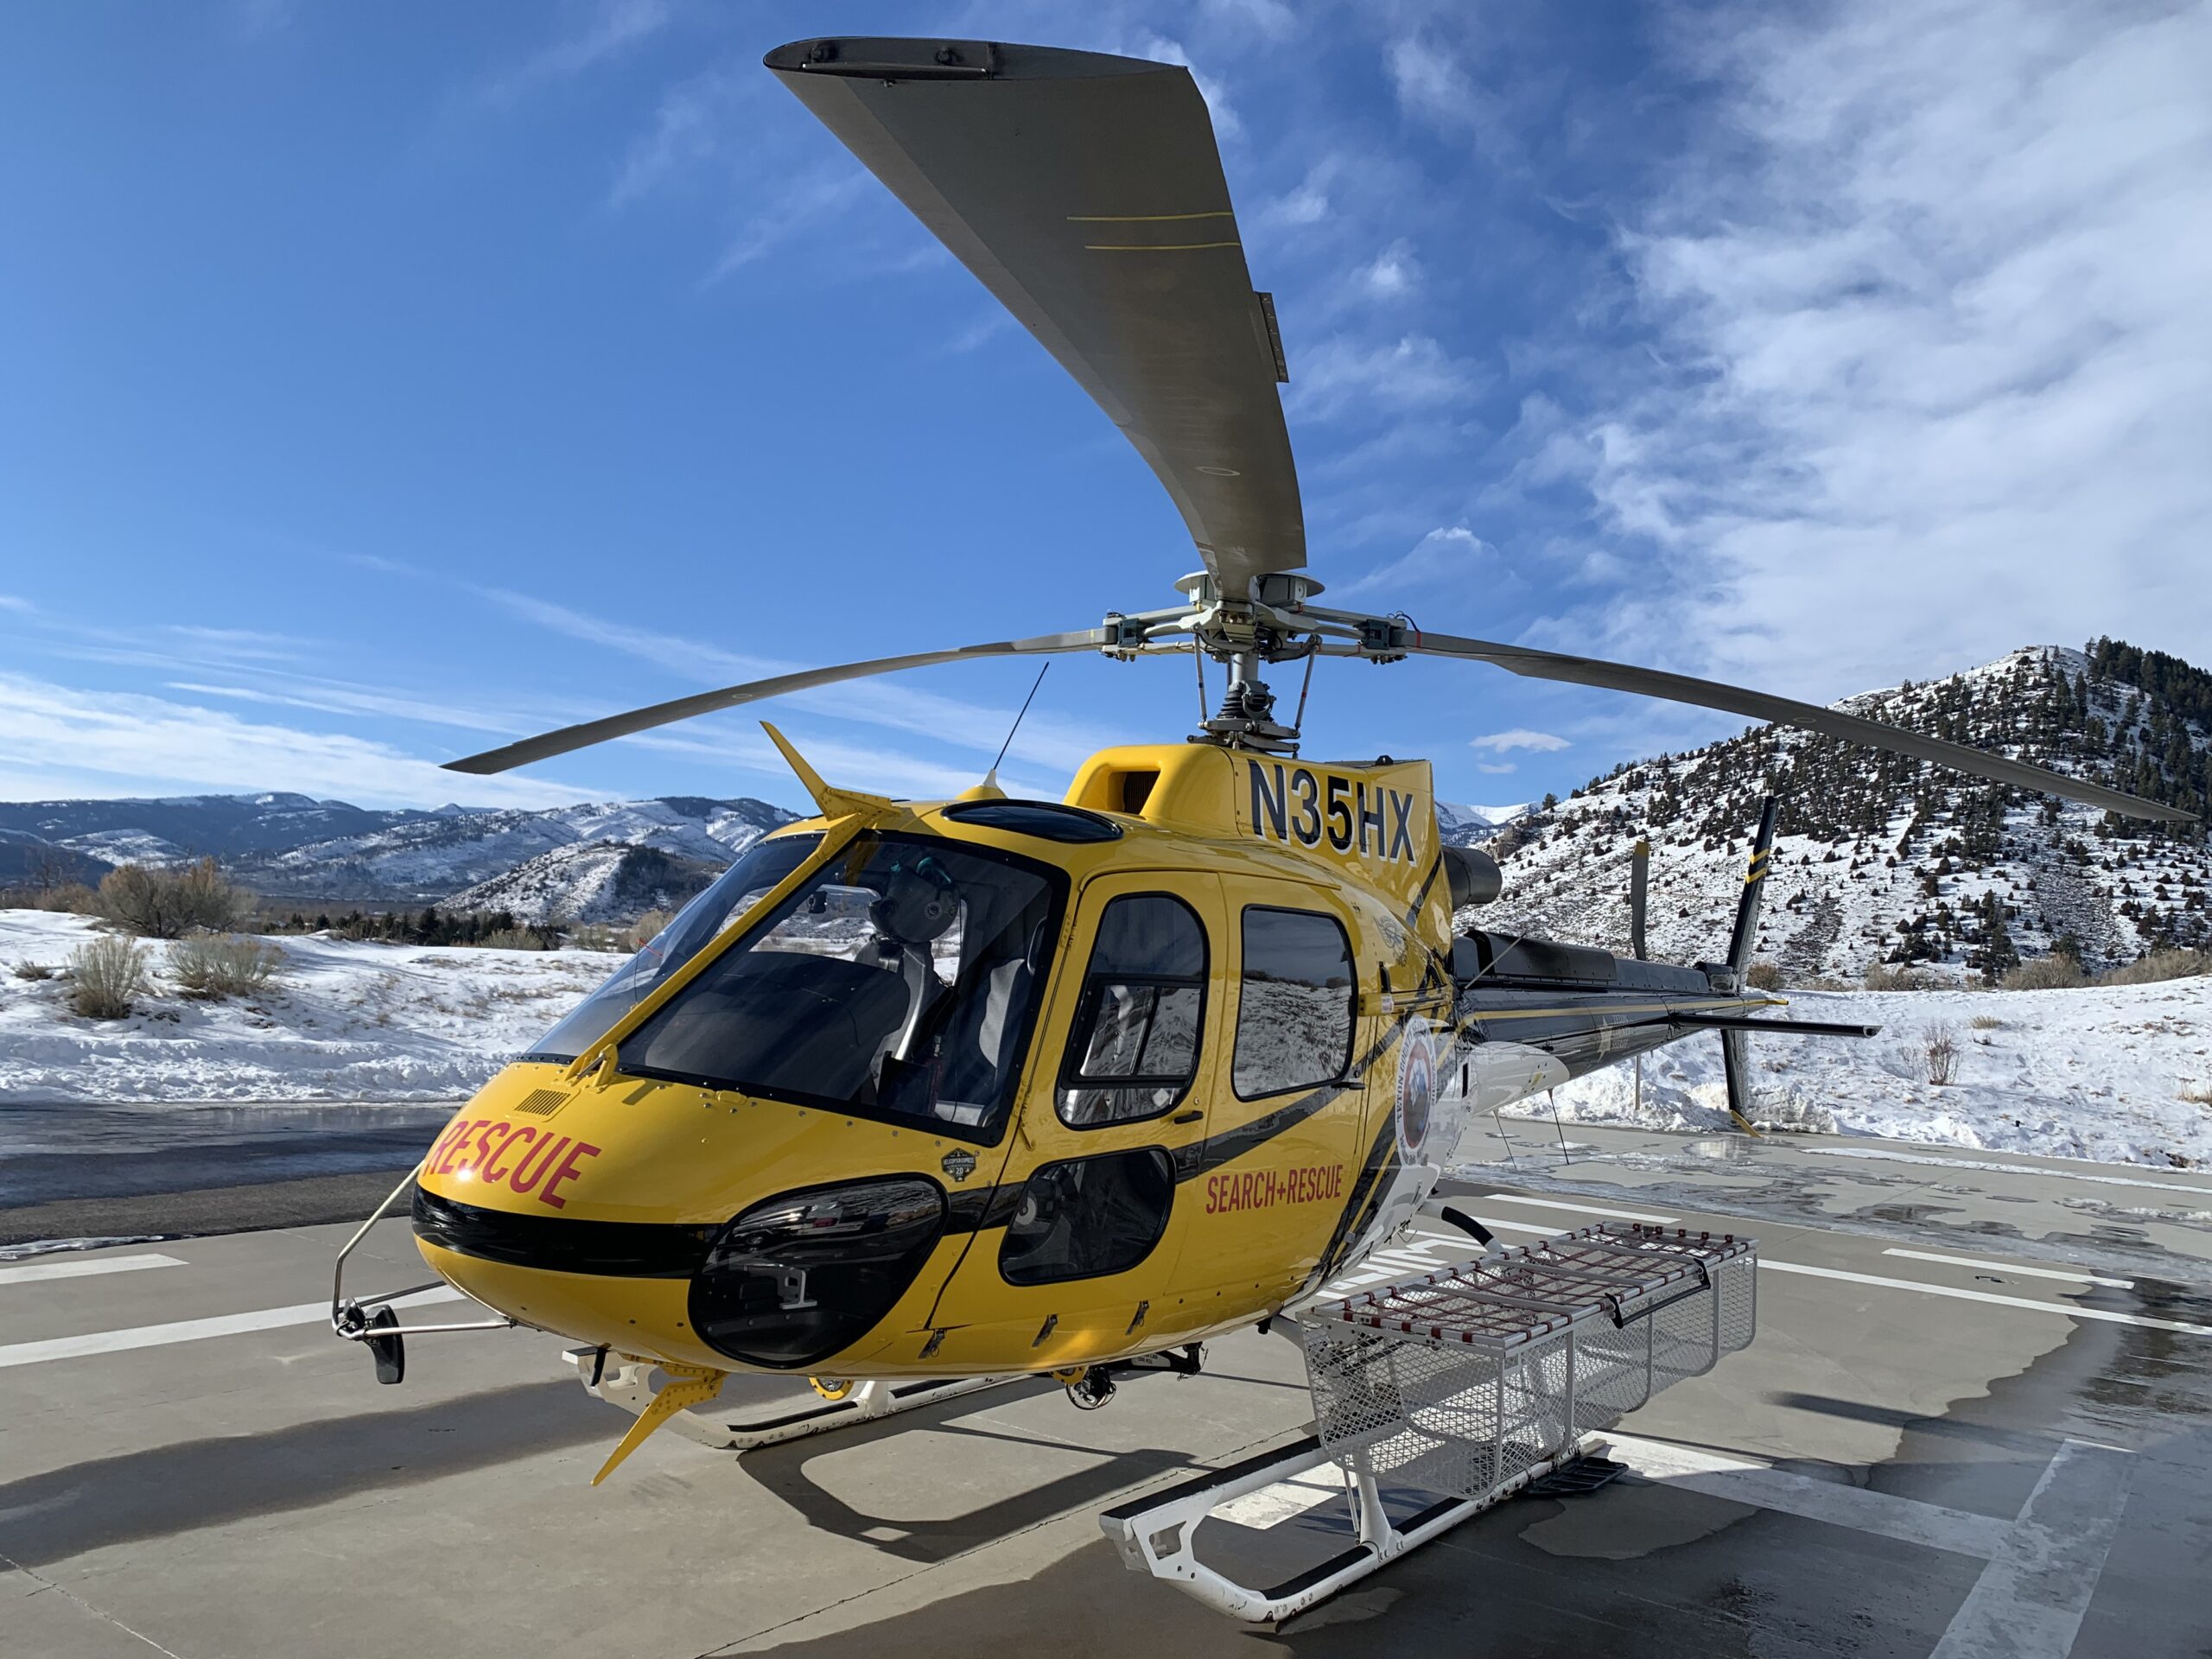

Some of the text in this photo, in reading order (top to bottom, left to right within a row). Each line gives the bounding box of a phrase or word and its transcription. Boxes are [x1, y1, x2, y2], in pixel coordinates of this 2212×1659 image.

[1247, 759, 1417, 868] N35HX
[423, 1120, 602, 1210] RESCUE
[1206, 1165, 1343, 1214] SEARCH+RESCUE
